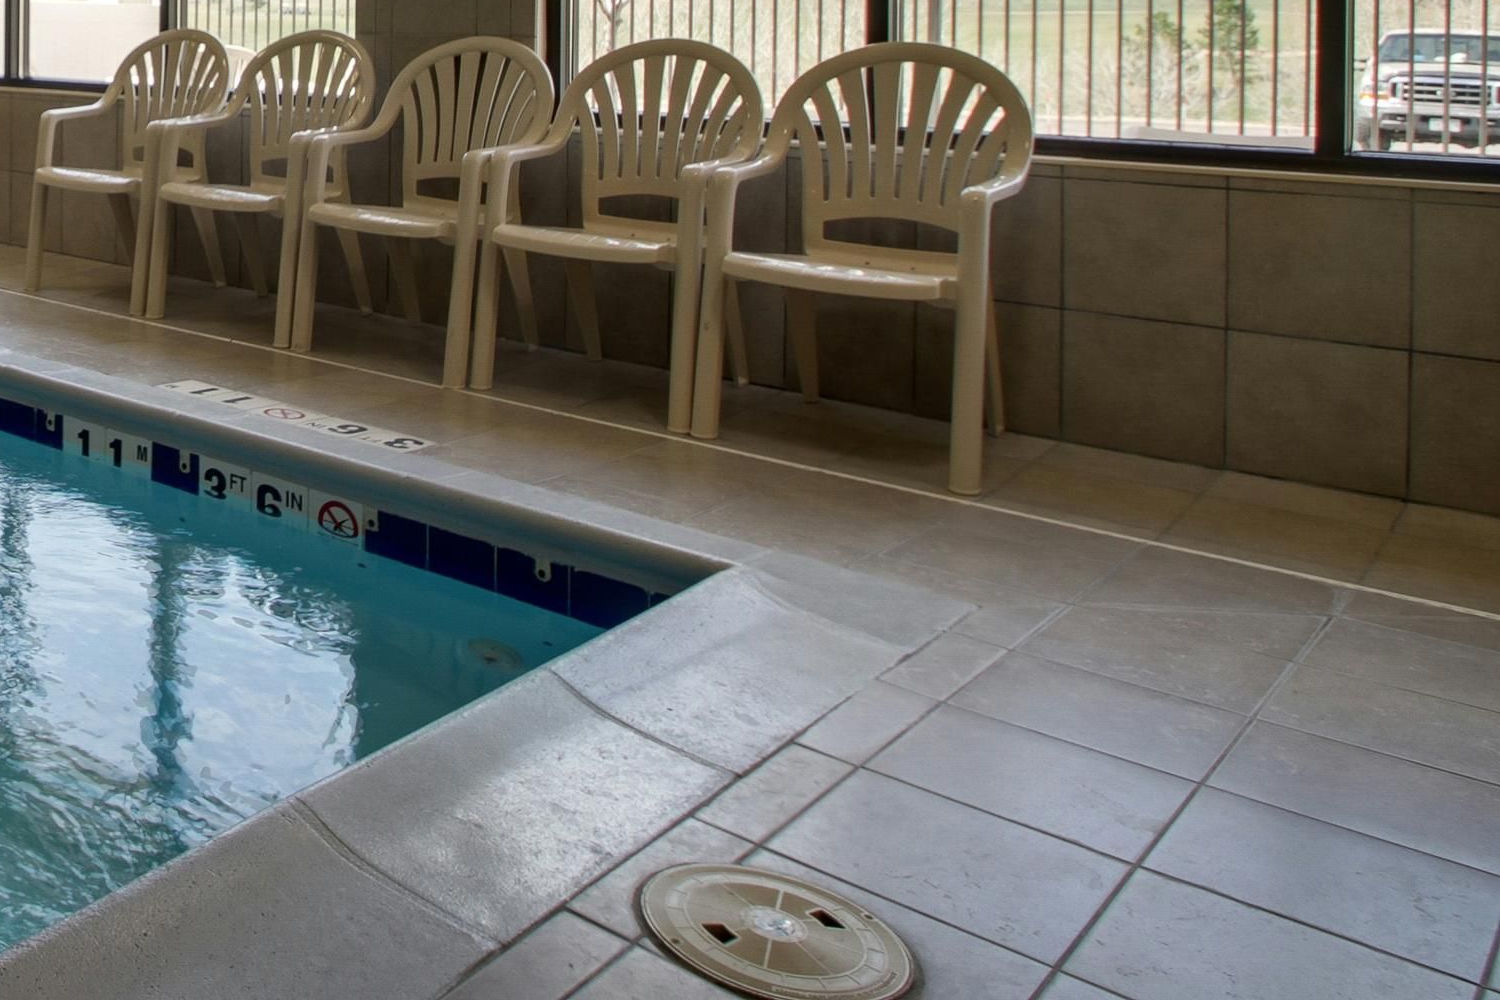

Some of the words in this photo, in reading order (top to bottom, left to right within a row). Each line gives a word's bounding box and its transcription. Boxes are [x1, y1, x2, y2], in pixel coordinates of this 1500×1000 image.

[328, 424, 368, 435] 6
[384, 437, 424, 450] 3
[136, 445, 148, 462] M
[203, 468, 227, 499] 3
[229, 473, 247, 494] FT
[256, 483, 282, 517] 6
[285, 490, 303, 511] IN
